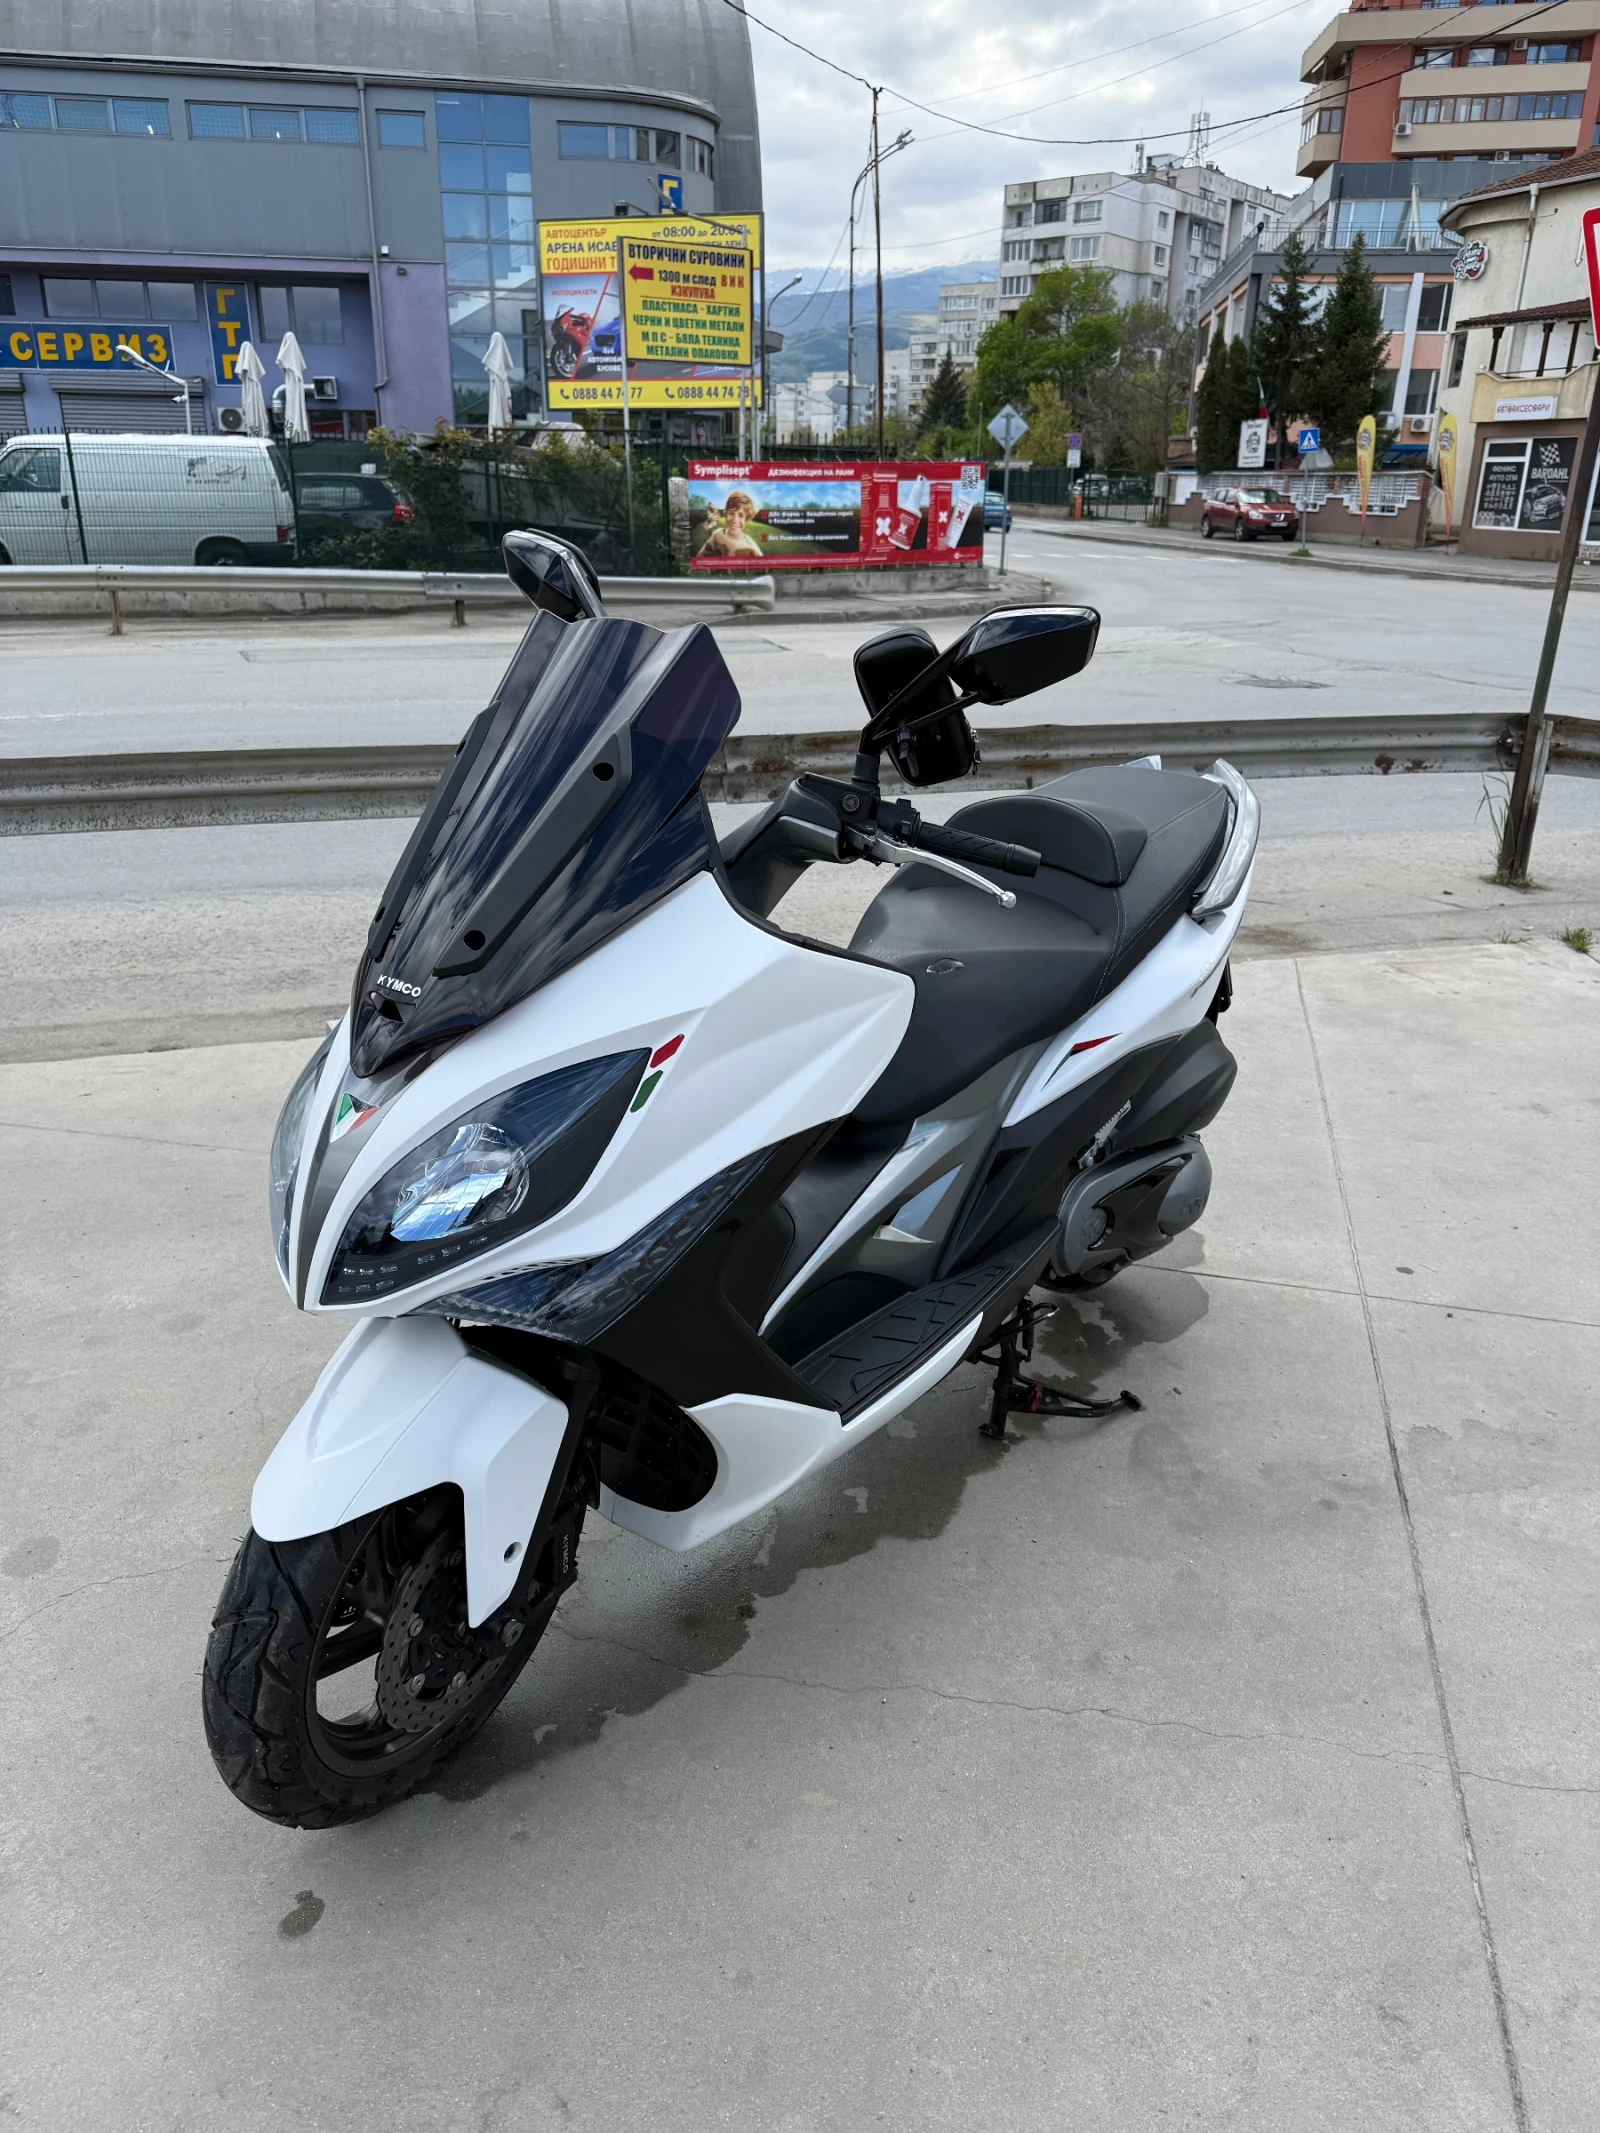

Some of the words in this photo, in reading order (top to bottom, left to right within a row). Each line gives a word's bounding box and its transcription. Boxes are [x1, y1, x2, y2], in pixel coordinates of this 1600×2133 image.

[545, 228, 608, 239] АВТОЦЕНТЪР
[662, 226, 696, 238] 08:00
[546, 242, 584, 253] АРЕНА
[546, 256, 606, 271] ГОДИШНИ
[628, 243, 687, 264] ВТОРИЧНИ
[689, 249, 745, 269] СУРОВИНИ
[658, 269, 681, 283] 1300
[692, 274, 717, 288] след
[670, 284, 716, 299] ИЗКУПУВА
[641, 299, 698, 314] ПЛАСТМАСА
[706, 304, 741, 317] ХАРТИЯ
[633, 314, 662, 327] ЧЕРНИ
[664, 316, 671, 327] И
[672, 317, 707, 330] ЦВЕТНИ
[709, 320, 745, 333] МЕТАЛИ
[9, 331, 168, 363] СЕРВИЗ
[675, 333, 701, 345] БЯЛА
[702, 335, 741, 348] ТЕХНИКА
[646, 345, 689, 358] МЕТАЛНИ
[691, 347, 739, 360] ОПАКОВКИ
[572, 388, 598, 400] 0888
[600, 388, 613, 400] 44
[630, 387, 643, 400] 77
[677, 386, 704, 399] 0888
[706, 386, 719, 399] 44
[722, 386, 734, 399] 74
[768, 468, 822, 478] ДЕЗИНФЕКЦИЯ
[835, 468, 854, 476] РАНИ
[1531, 467, 1569, 480] BARDAHL
[376, 974, 422, 998] KYMCO
